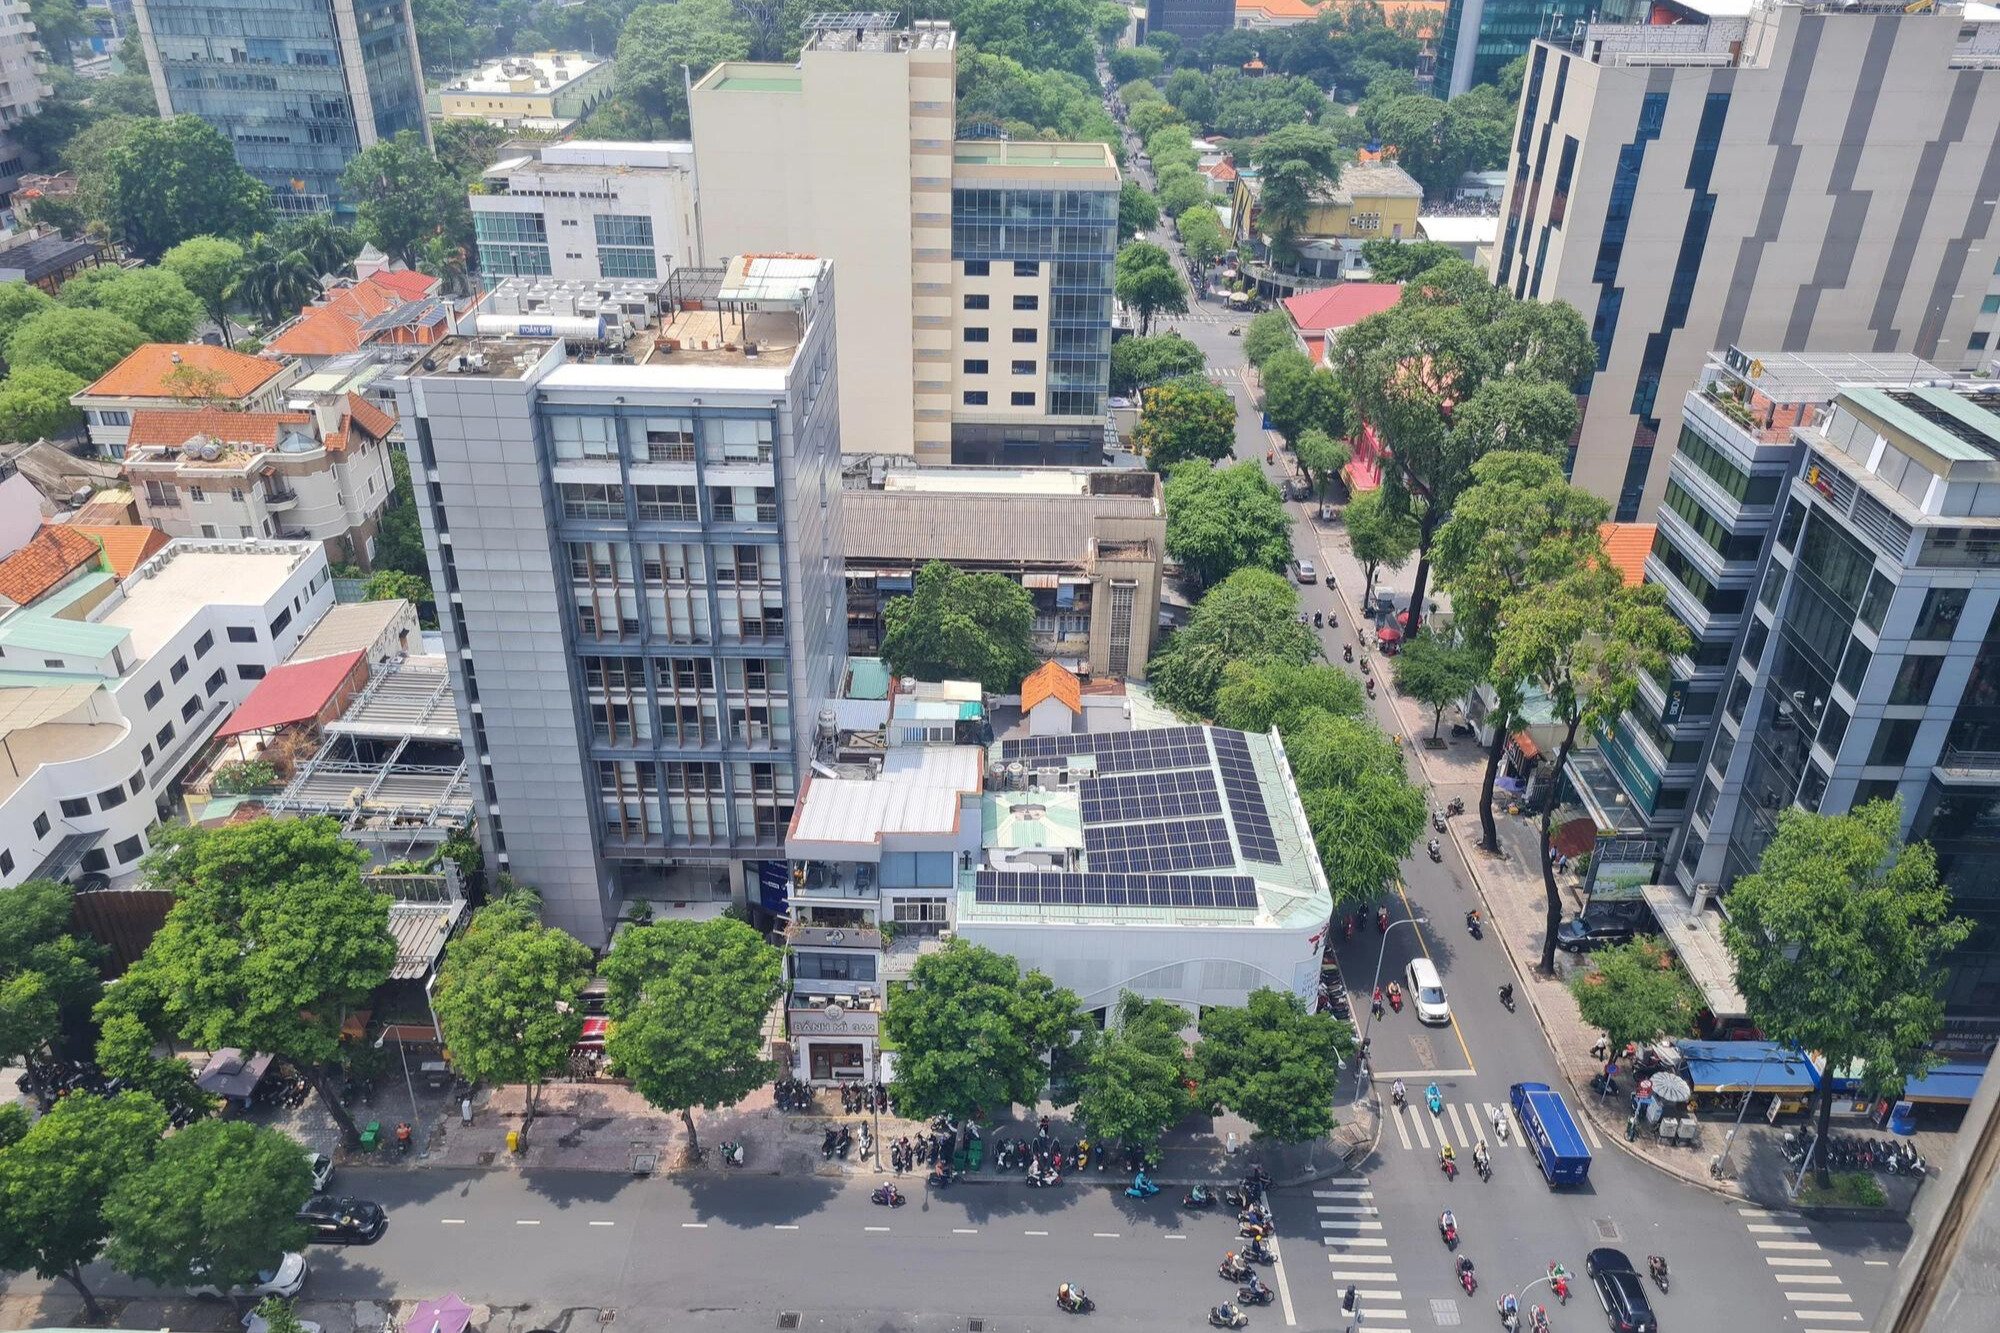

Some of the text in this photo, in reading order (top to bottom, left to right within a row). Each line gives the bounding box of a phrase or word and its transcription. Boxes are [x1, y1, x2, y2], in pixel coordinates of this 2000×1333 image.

[1725, 346, 1752, 377] BIDV
[1669, 697, 1680, 715] BIDV
[794, 1020, 876, 1033] BÁNH MÌ 362
